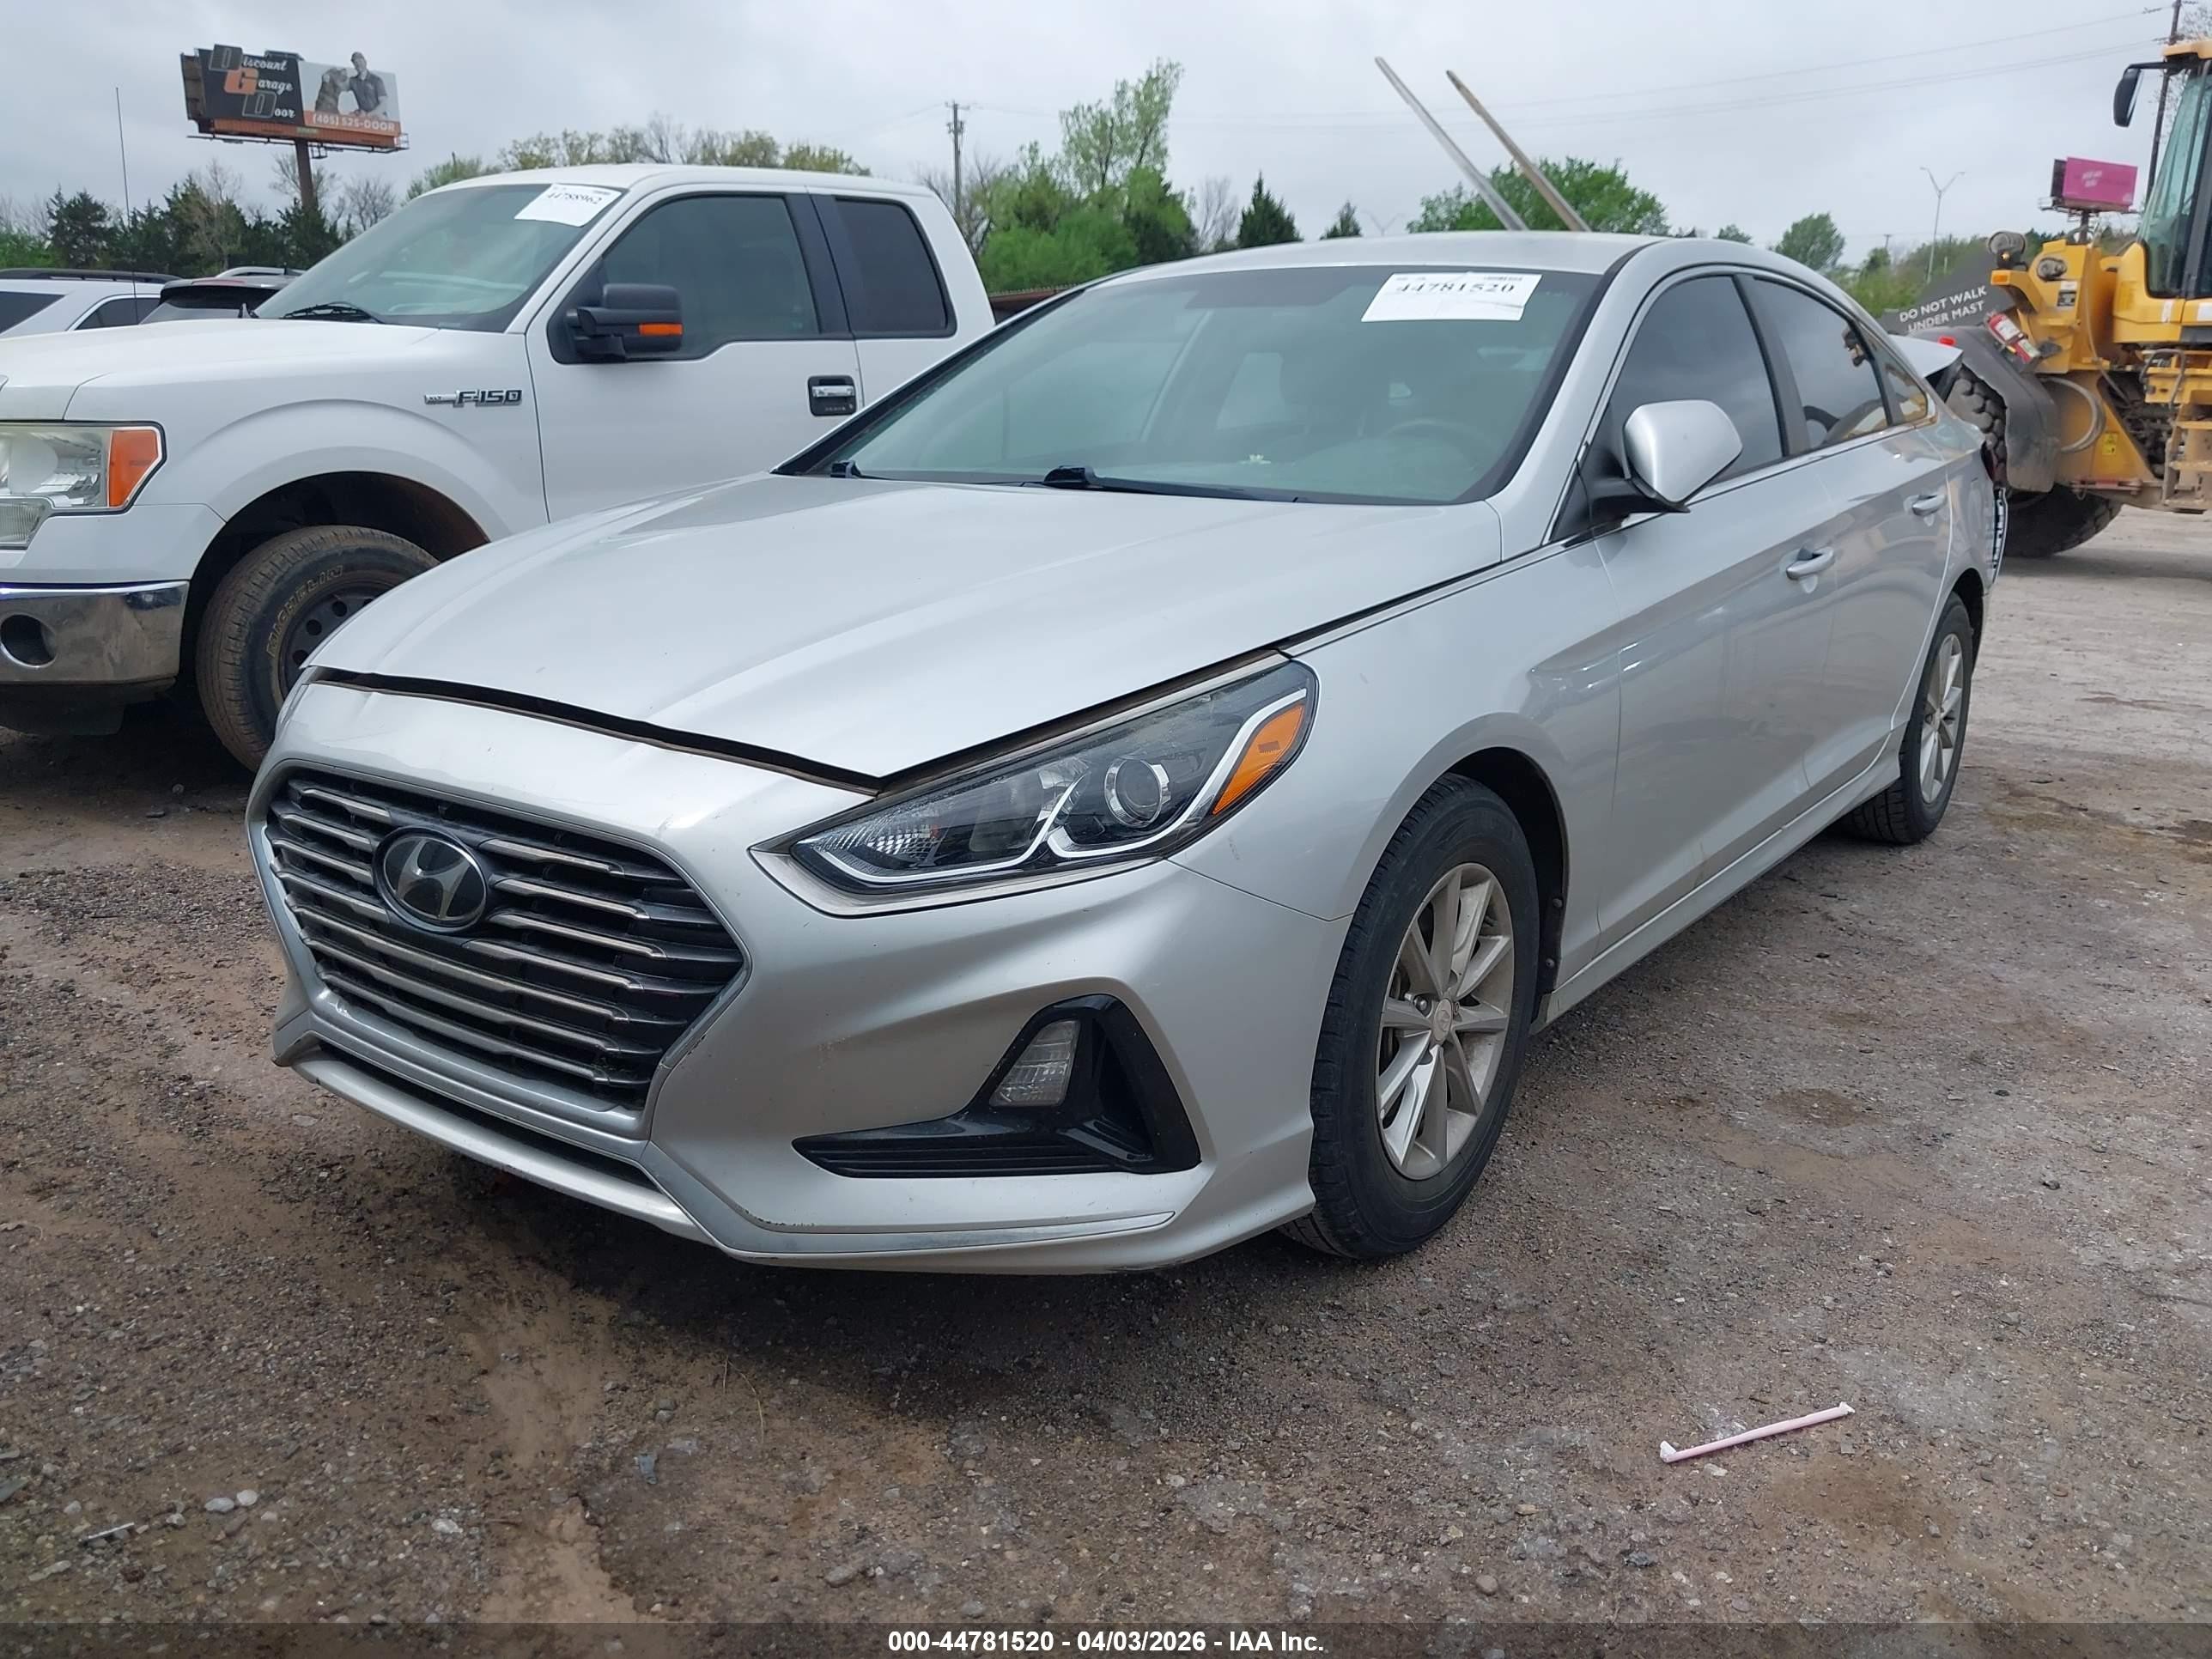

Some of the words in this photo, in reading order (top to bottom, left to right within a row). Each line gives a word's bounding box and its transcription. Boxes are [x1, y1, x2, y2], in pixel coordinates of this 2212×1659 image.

[342, 118, 395, 131] 525-DOOR
[1396, 283, 1516, 293] 44781520
[1899, 309, 1917, 323] DO
[1921, 297, 1948, 314] NOT
[1950, 285, 1988, 305] WALK
[1908, 313, 1949, 333] UNDER
[1952, 301, 1984, 320] MAST
